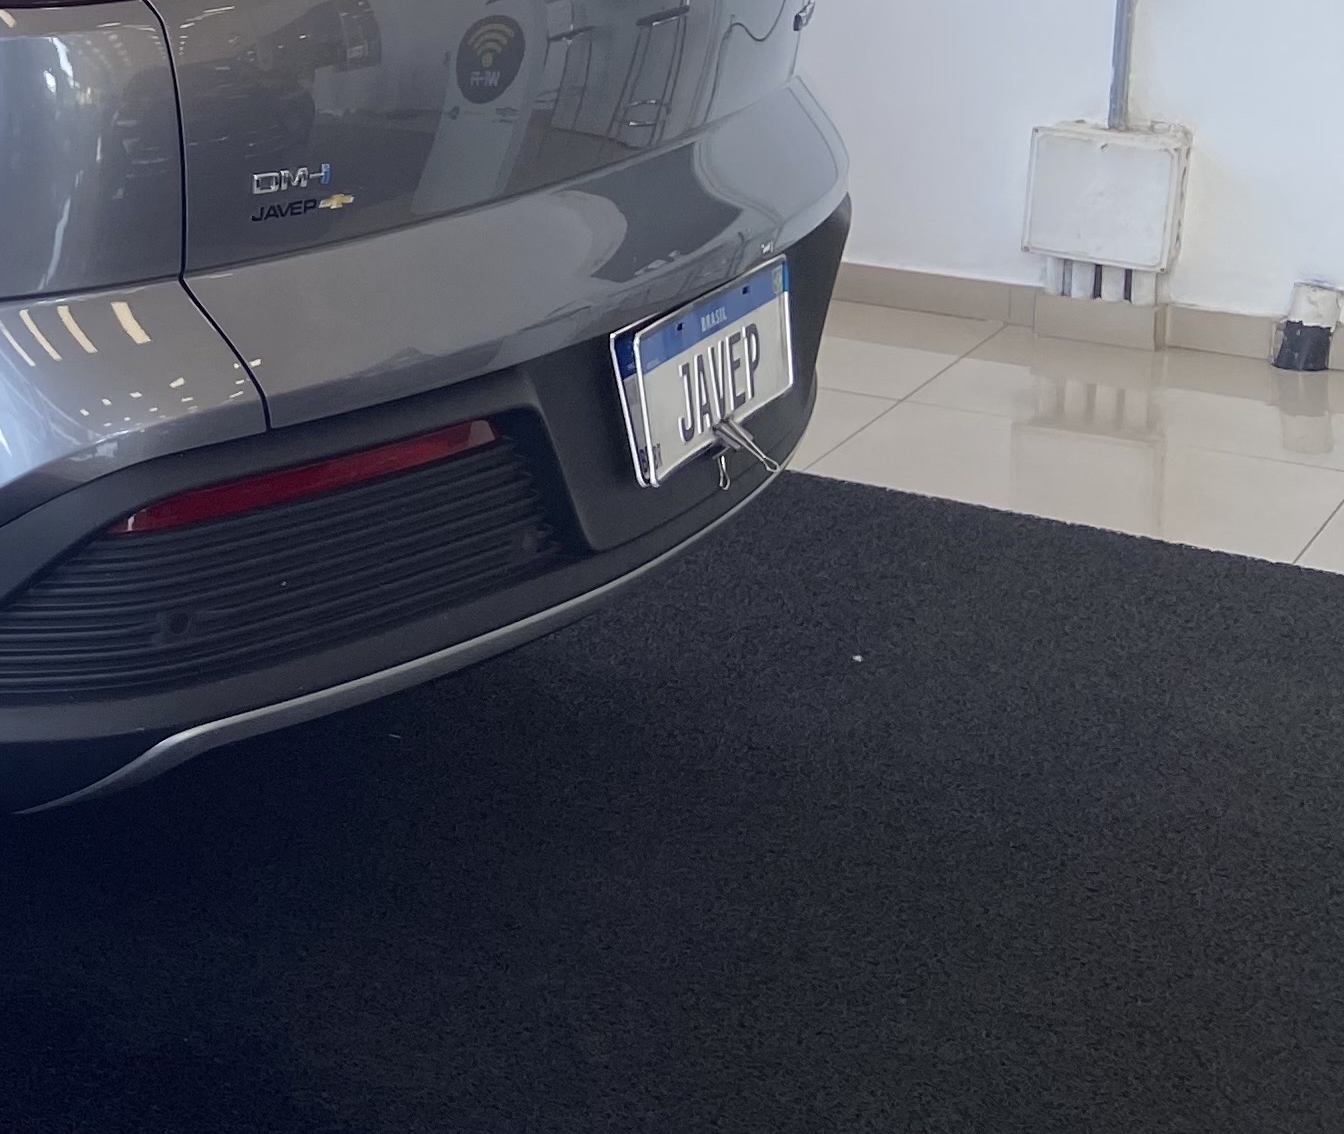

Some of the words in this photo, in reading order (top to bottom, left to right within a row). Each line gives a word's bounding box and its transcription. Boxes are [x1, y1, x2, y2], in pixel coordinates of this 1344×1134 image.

[251, 199, 318, 222] JAVEP
[700, 307, 728, 333] BRASIL
[678, 323, 761, 443] JAVEP
